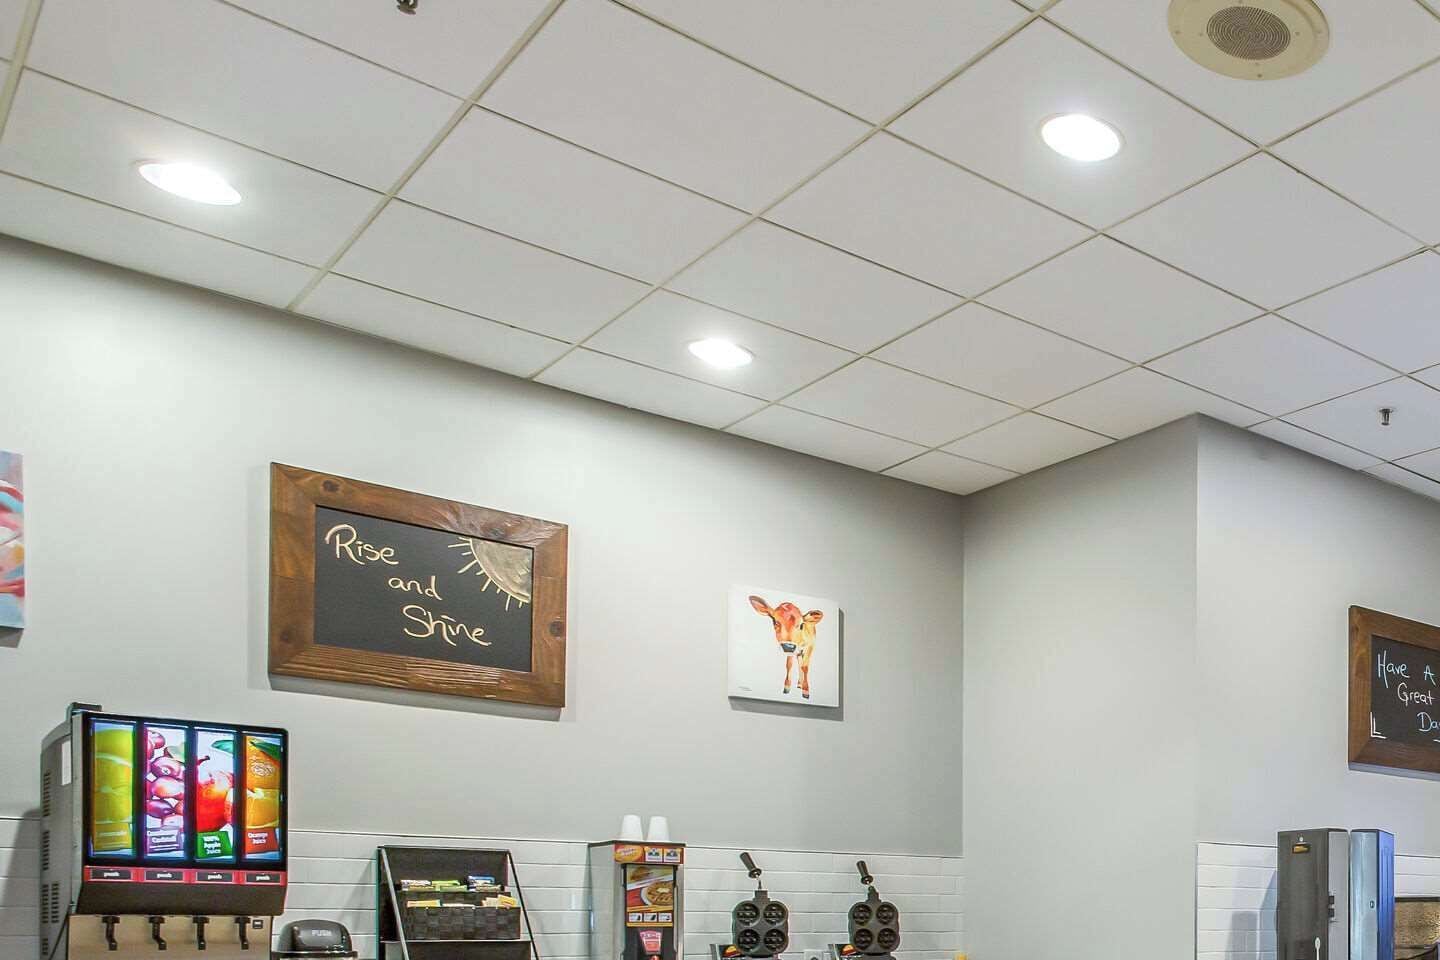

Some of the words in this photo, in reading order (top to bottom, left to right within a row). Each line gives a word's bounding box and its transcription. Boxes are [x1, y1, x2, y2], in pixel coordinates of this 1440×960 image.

[325, 523, 399, 565] Rise
[388, 575, 443, 600] and
[402, 604, 492, 646] Shine
[1377, 650, 1411, 688] Have
[1423, 664, 1436, 686] A
[1397, 682, 1436, 707] Great
